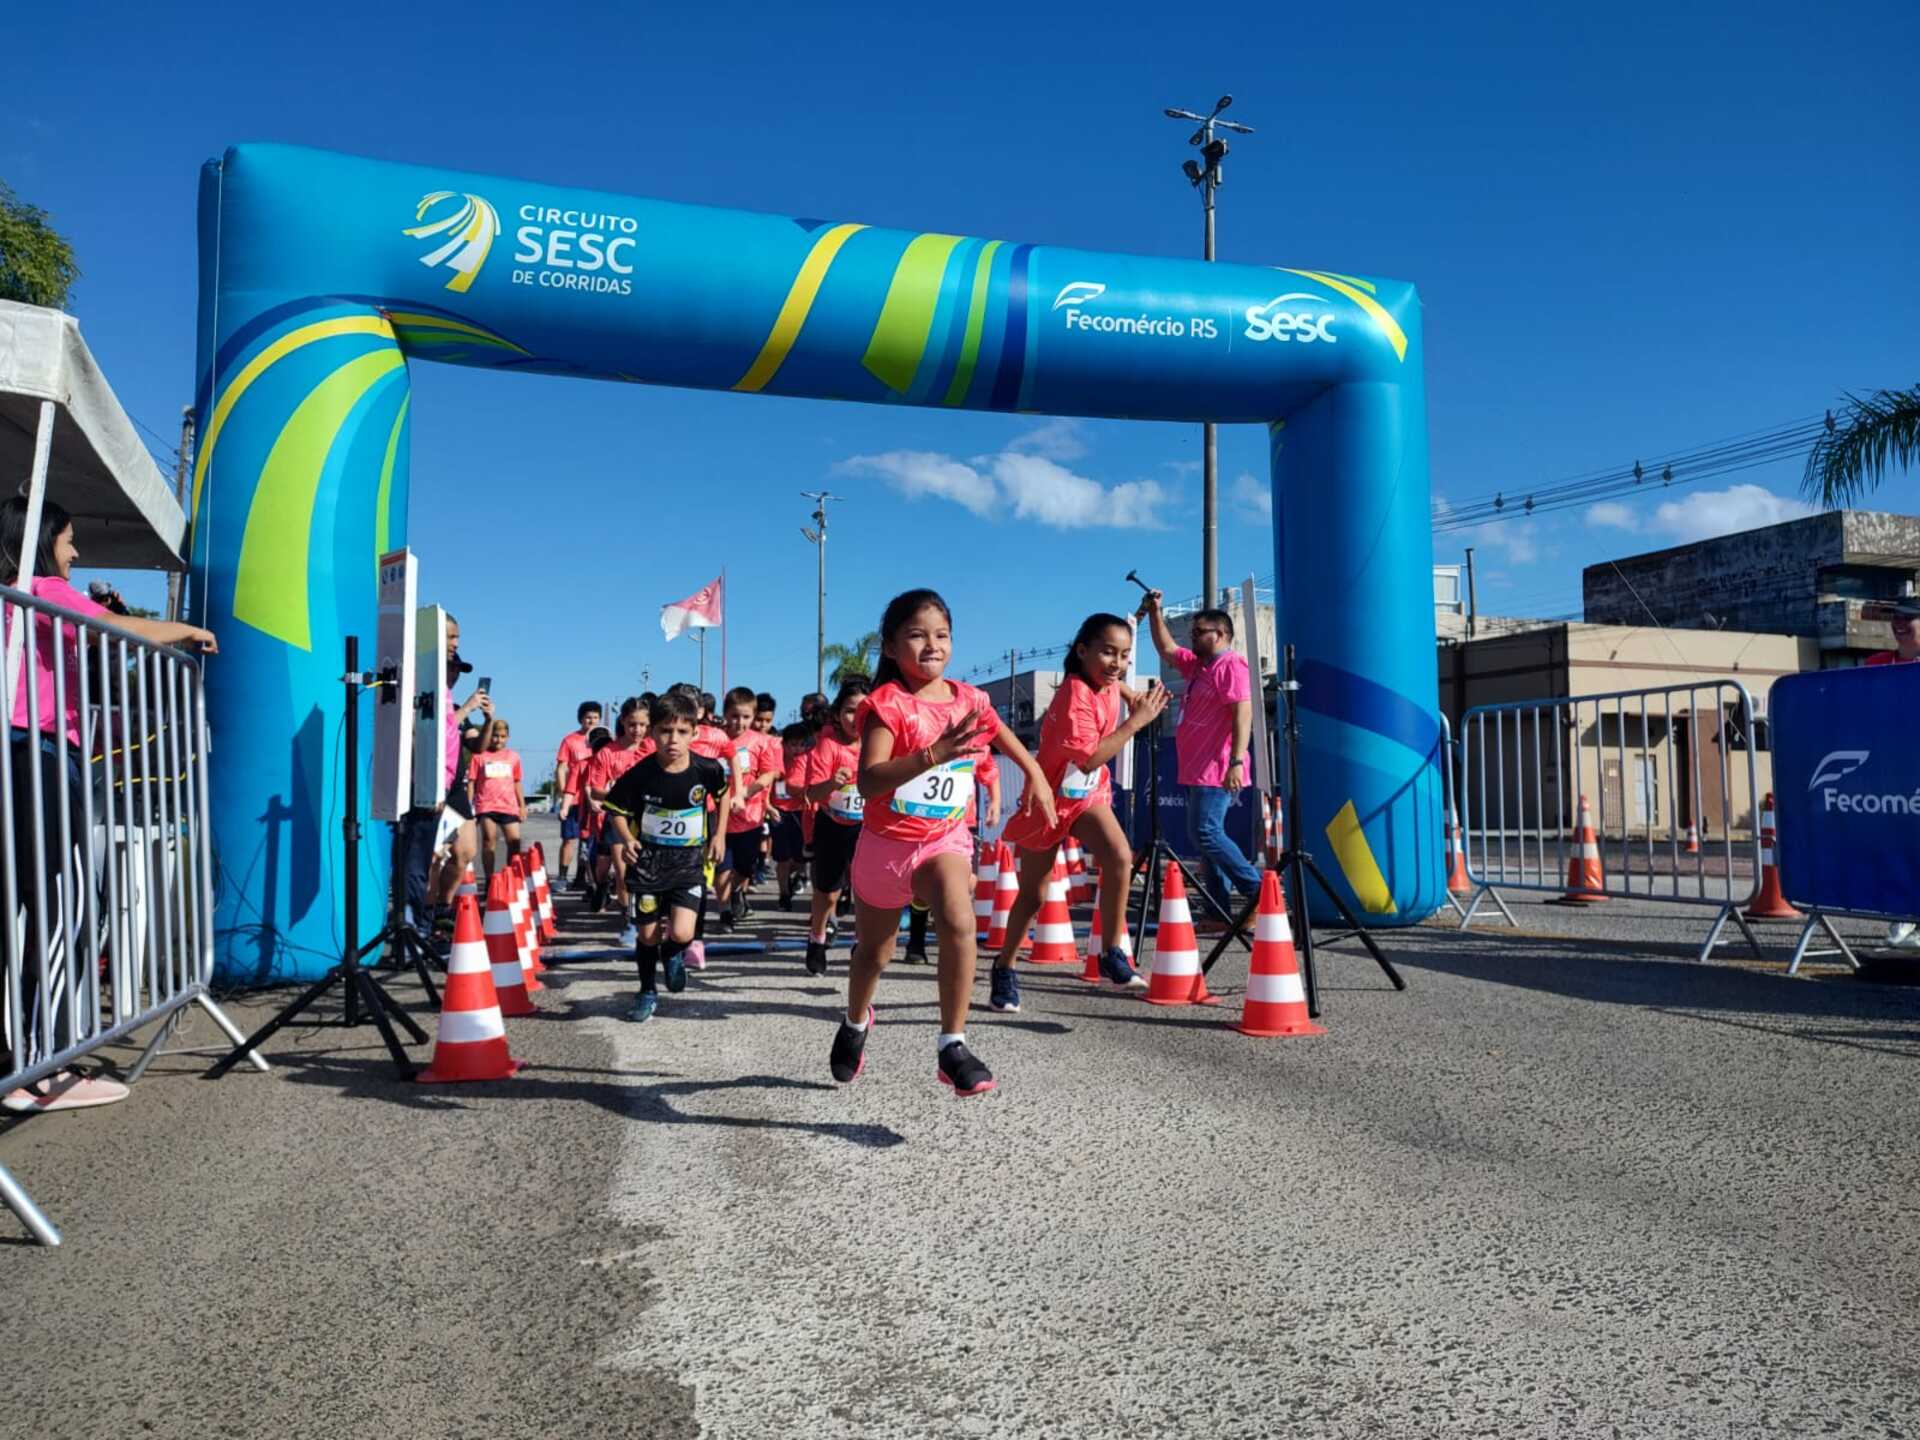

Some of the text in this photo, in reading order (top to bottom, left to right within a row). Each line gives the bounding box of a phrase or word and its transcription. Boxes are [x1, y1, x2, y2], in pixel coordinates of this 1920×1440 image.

[519, 204, 638, 234] CIRCUITO
[513, 225, 637, 275] SESC
[511, 269, 632, 295] DE CORRIDAS
[1066, 308, 1218, 339] Fecomércio RS
[923, 775, 954, 802] 30
[843, 796, 864, 810] 19
[660, 820, 687, 836] 20
